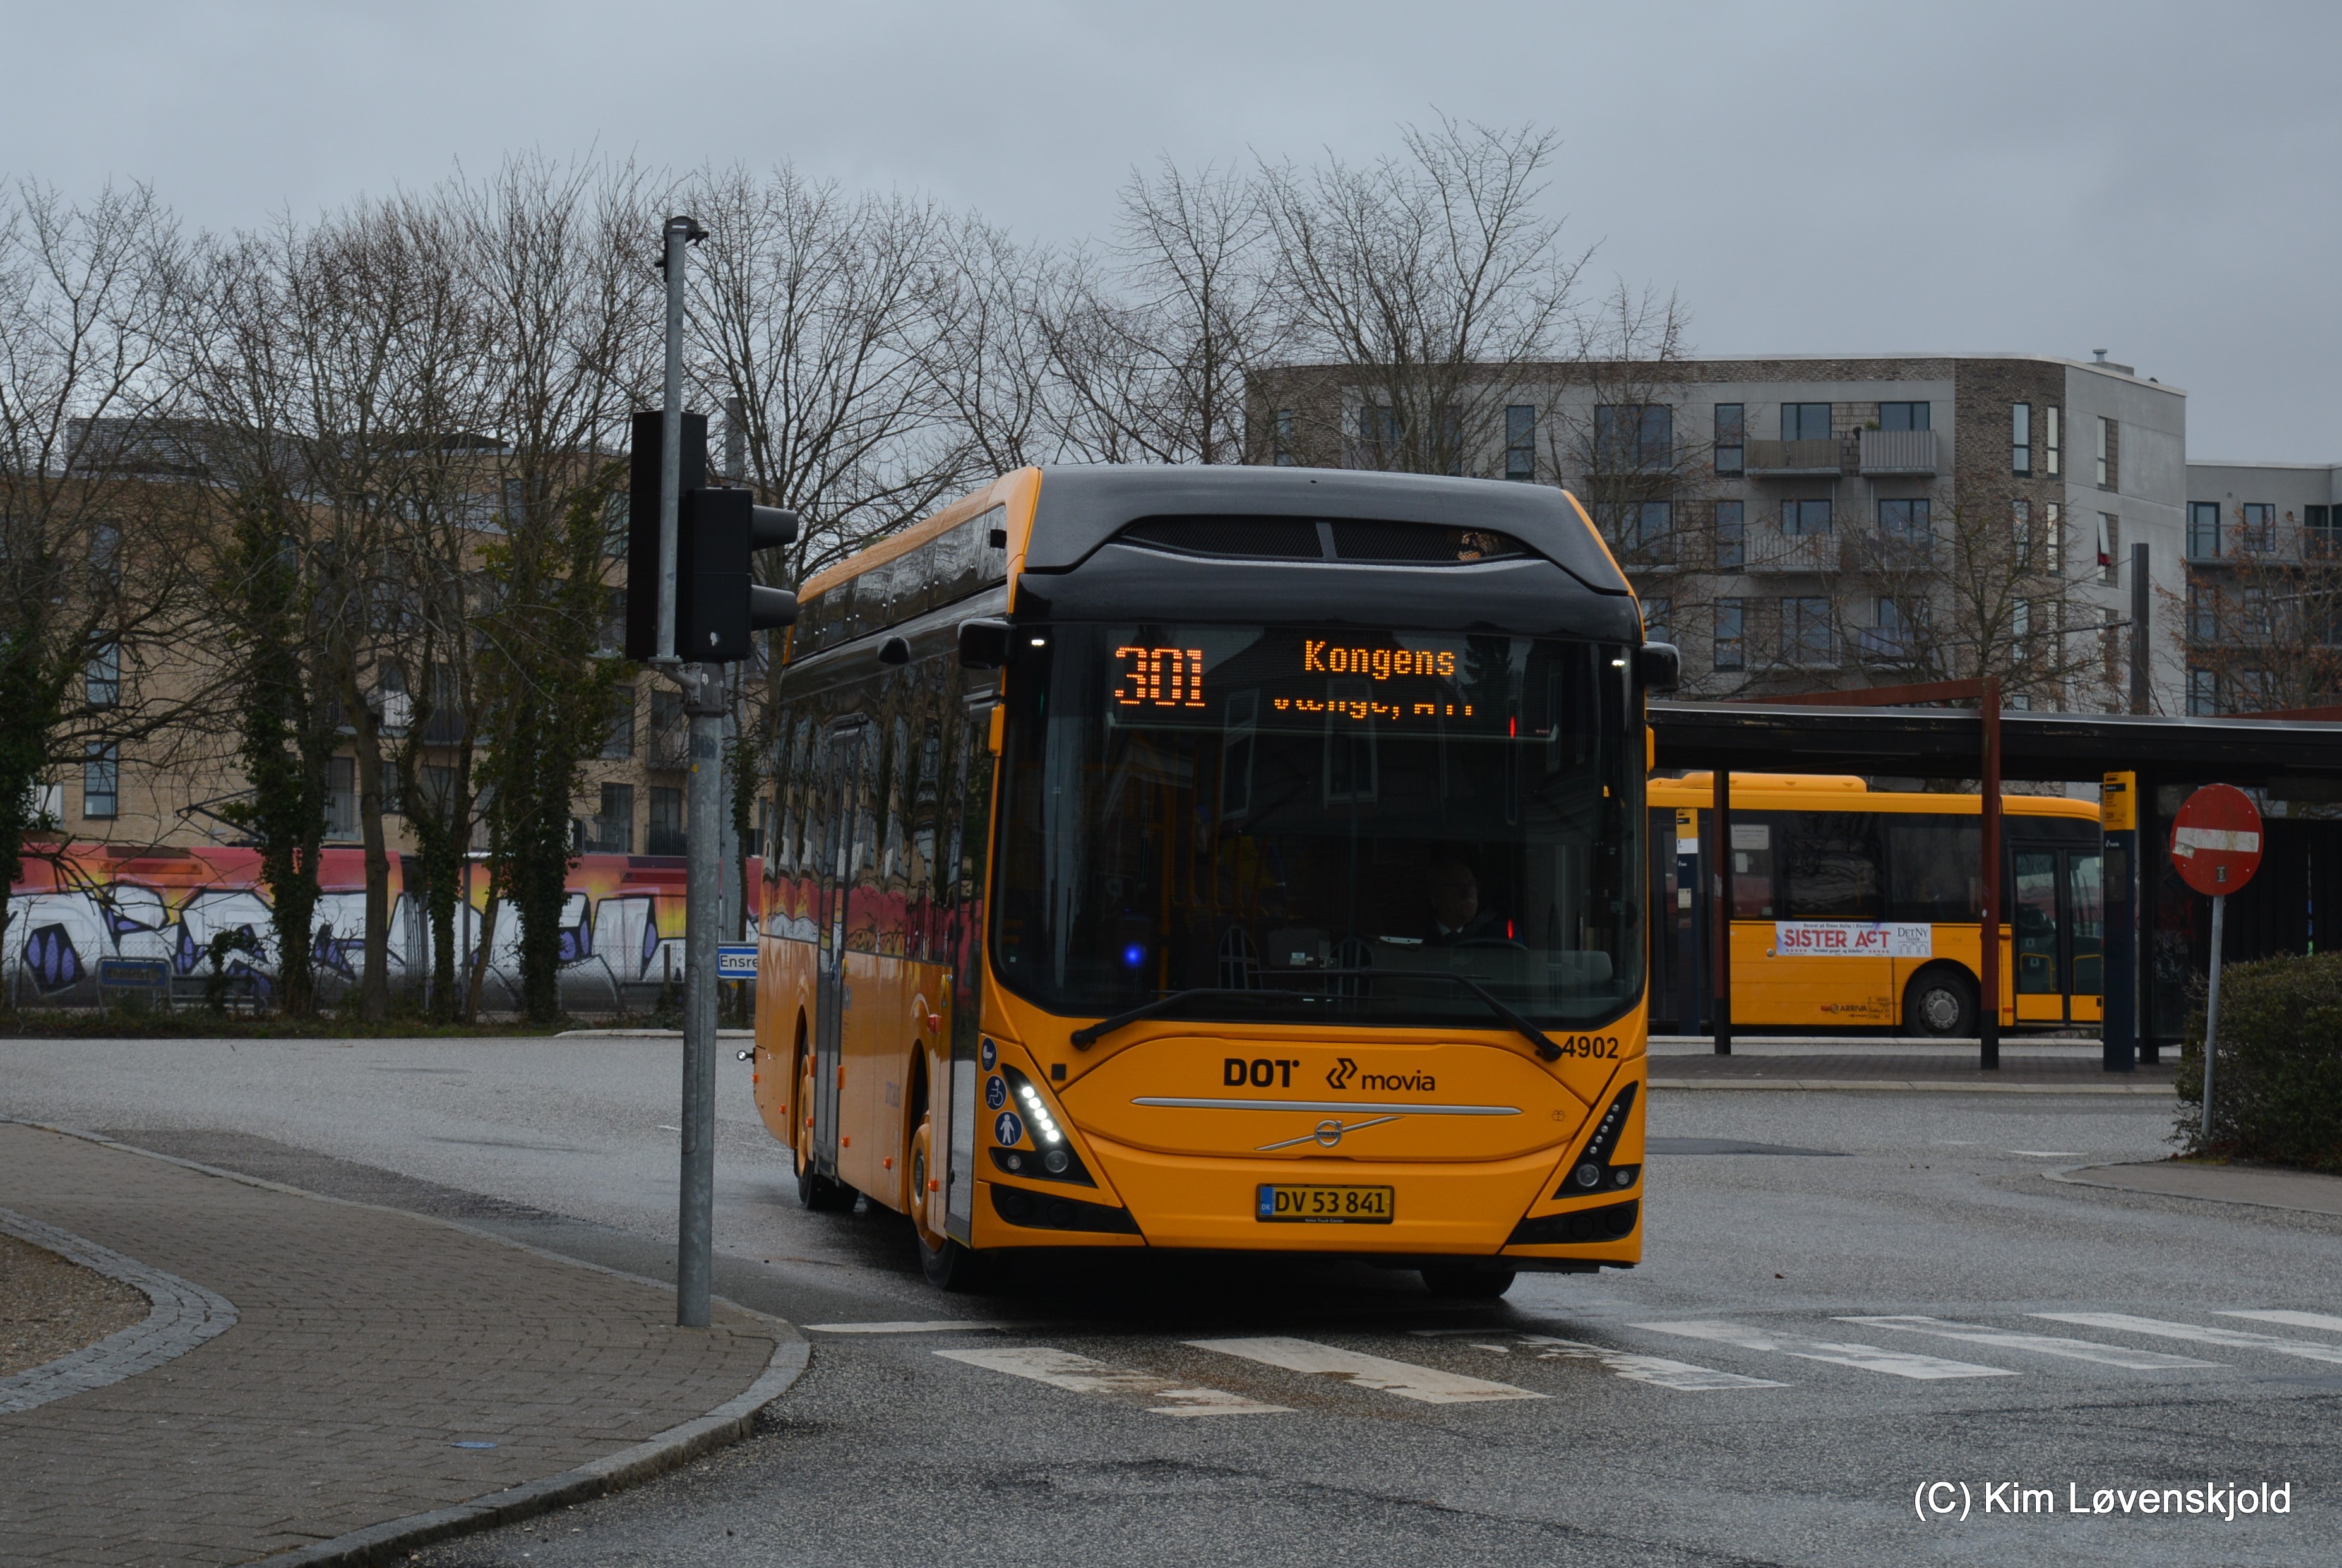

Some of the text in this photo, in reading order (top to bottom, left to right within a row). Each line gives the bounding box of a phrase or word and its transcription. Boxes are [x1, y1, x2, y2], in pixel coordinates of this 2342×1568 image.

[1305, 640, 1456, 681] Kongens
[1115, 647, 1207, 708] 301
[1784, 928, 1891, 949] SISTER ACT
[1562, 1035, 1618, 1060] 4902
[1223, 1058, 1300, 1089] DOT
[1361, 1070, 1436, 1092] movia
[1276, 1191, 1385, 1213] DV 53 841
